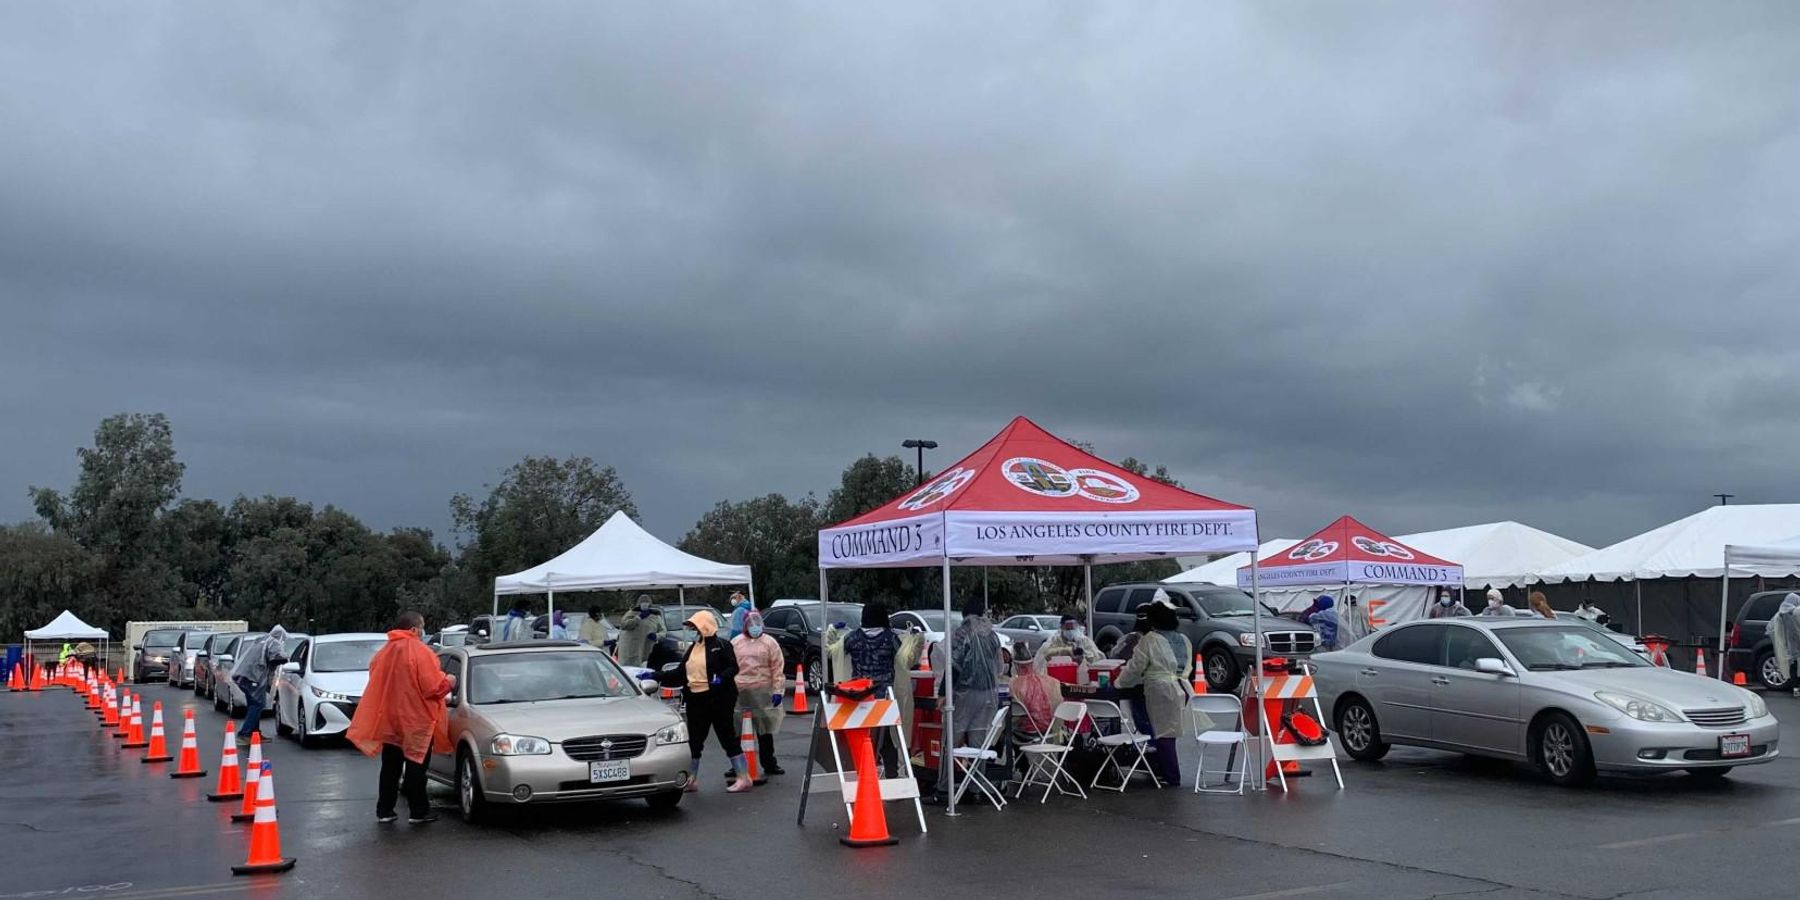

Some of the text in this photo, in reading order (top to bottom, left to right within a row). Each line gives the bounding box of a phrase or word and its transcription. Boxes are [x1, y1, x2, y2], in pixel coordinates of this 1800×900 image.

[976, 522, 1233, 540] LOS ANGELES COUNTY FIRE DEPT.
[832, 524, 923, 559] COMMAND 3
[1281, 570, 1304, 579] COUNTY
[1363, 564, 1447, 582] COMMAND 3
